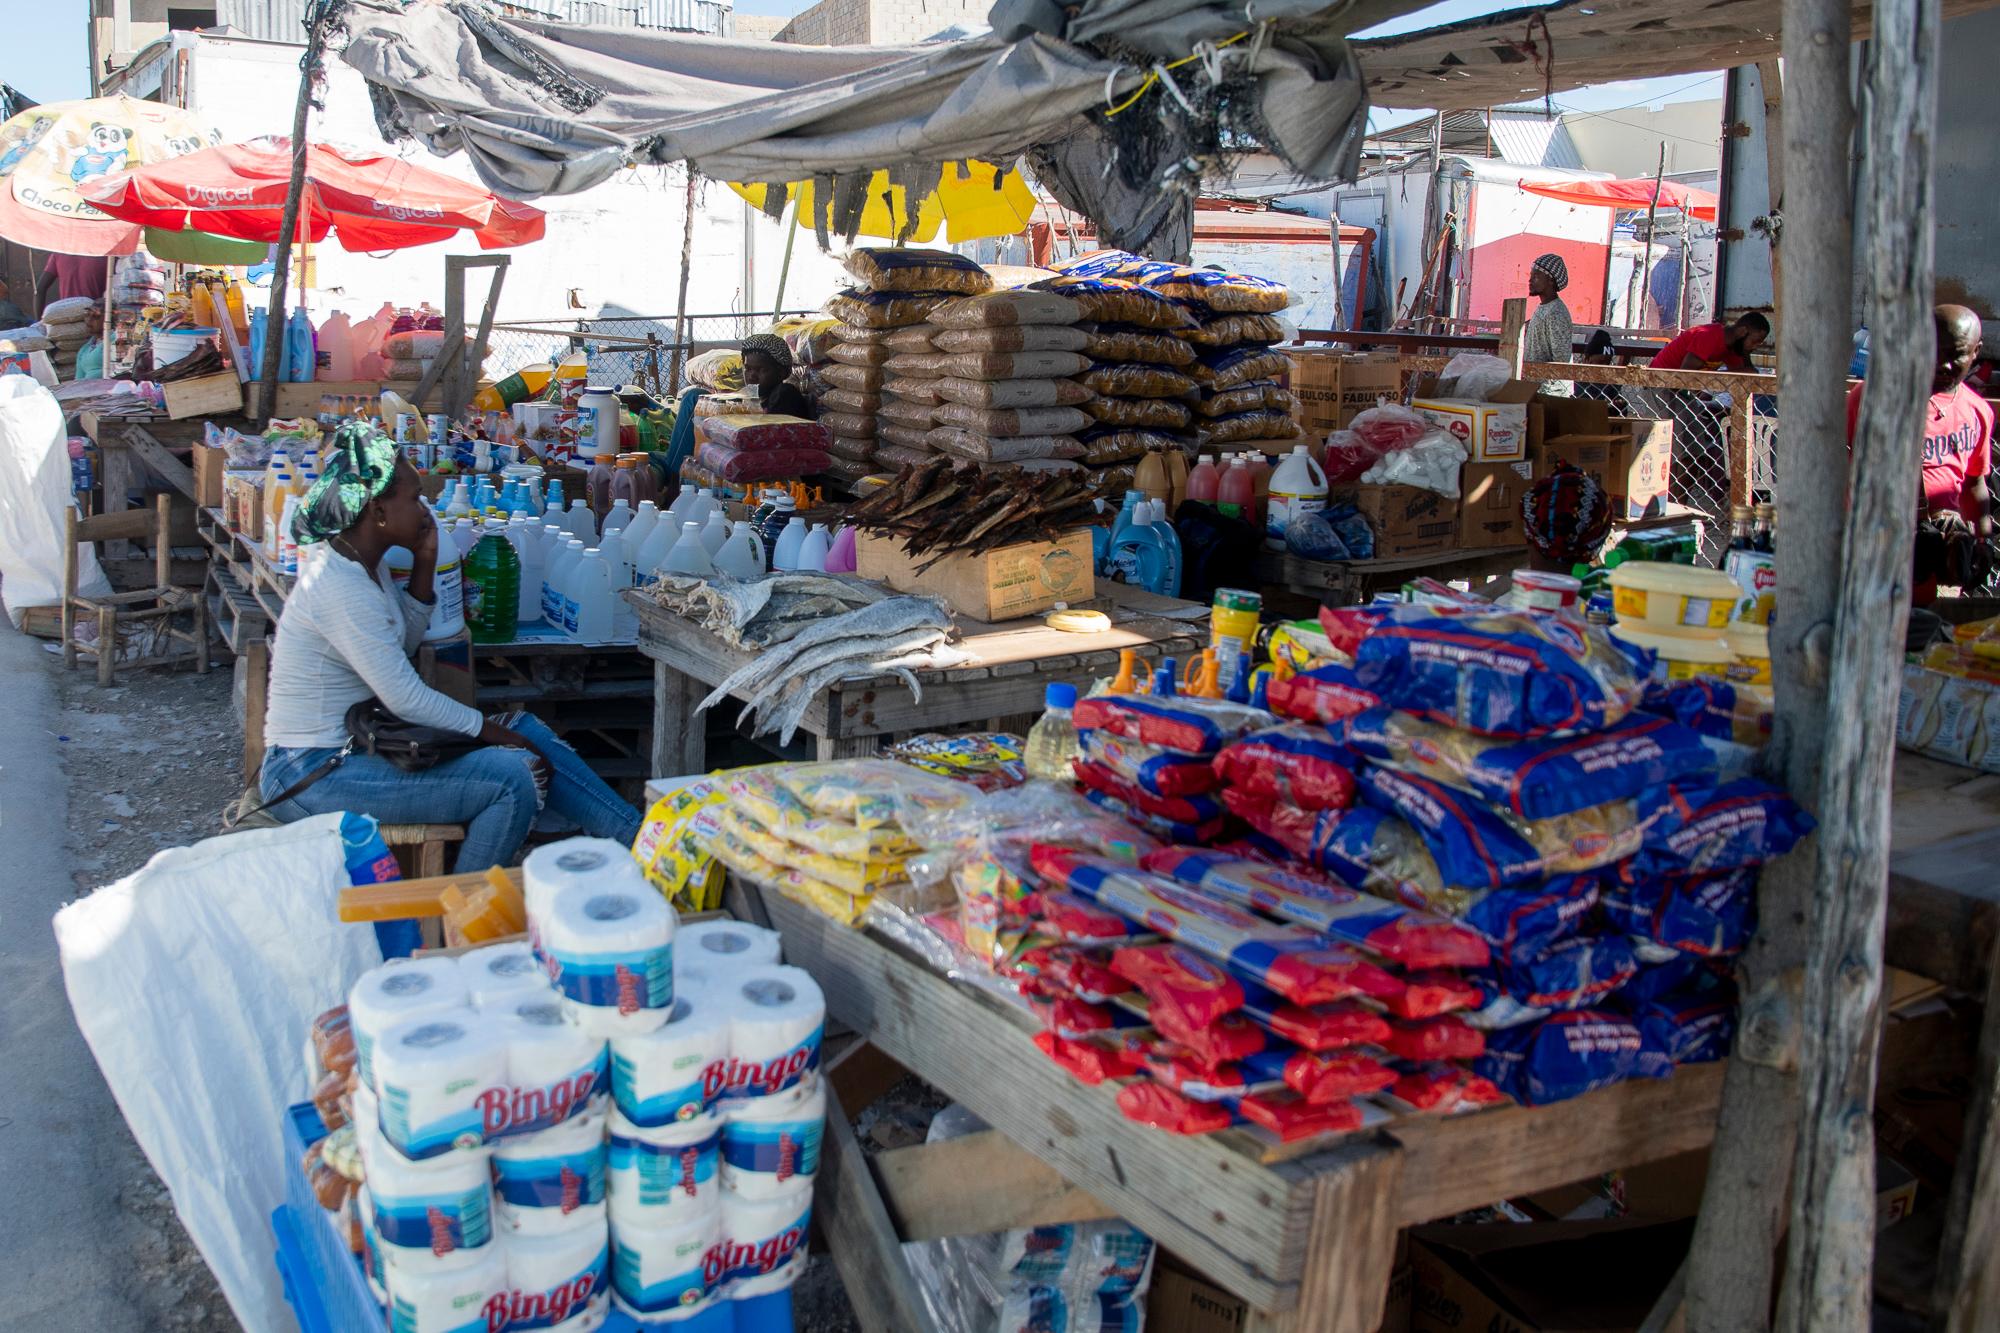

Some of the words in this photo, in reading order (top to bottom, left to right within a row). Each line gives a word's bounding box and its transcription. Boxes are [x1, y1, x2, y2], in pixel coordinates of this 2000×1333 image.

[20, 187, 72, 213] Choco
[185, 184, 256, 206] Digicel
[371, 199, 445, 220] Digicel
[698, 1045, 814, 1100] Bingo
[474, 1070, 600, 1137] Bingo
[698, 1222, 805, 1285] Bingo
[480, 1268, 600, 1333] Bingo
